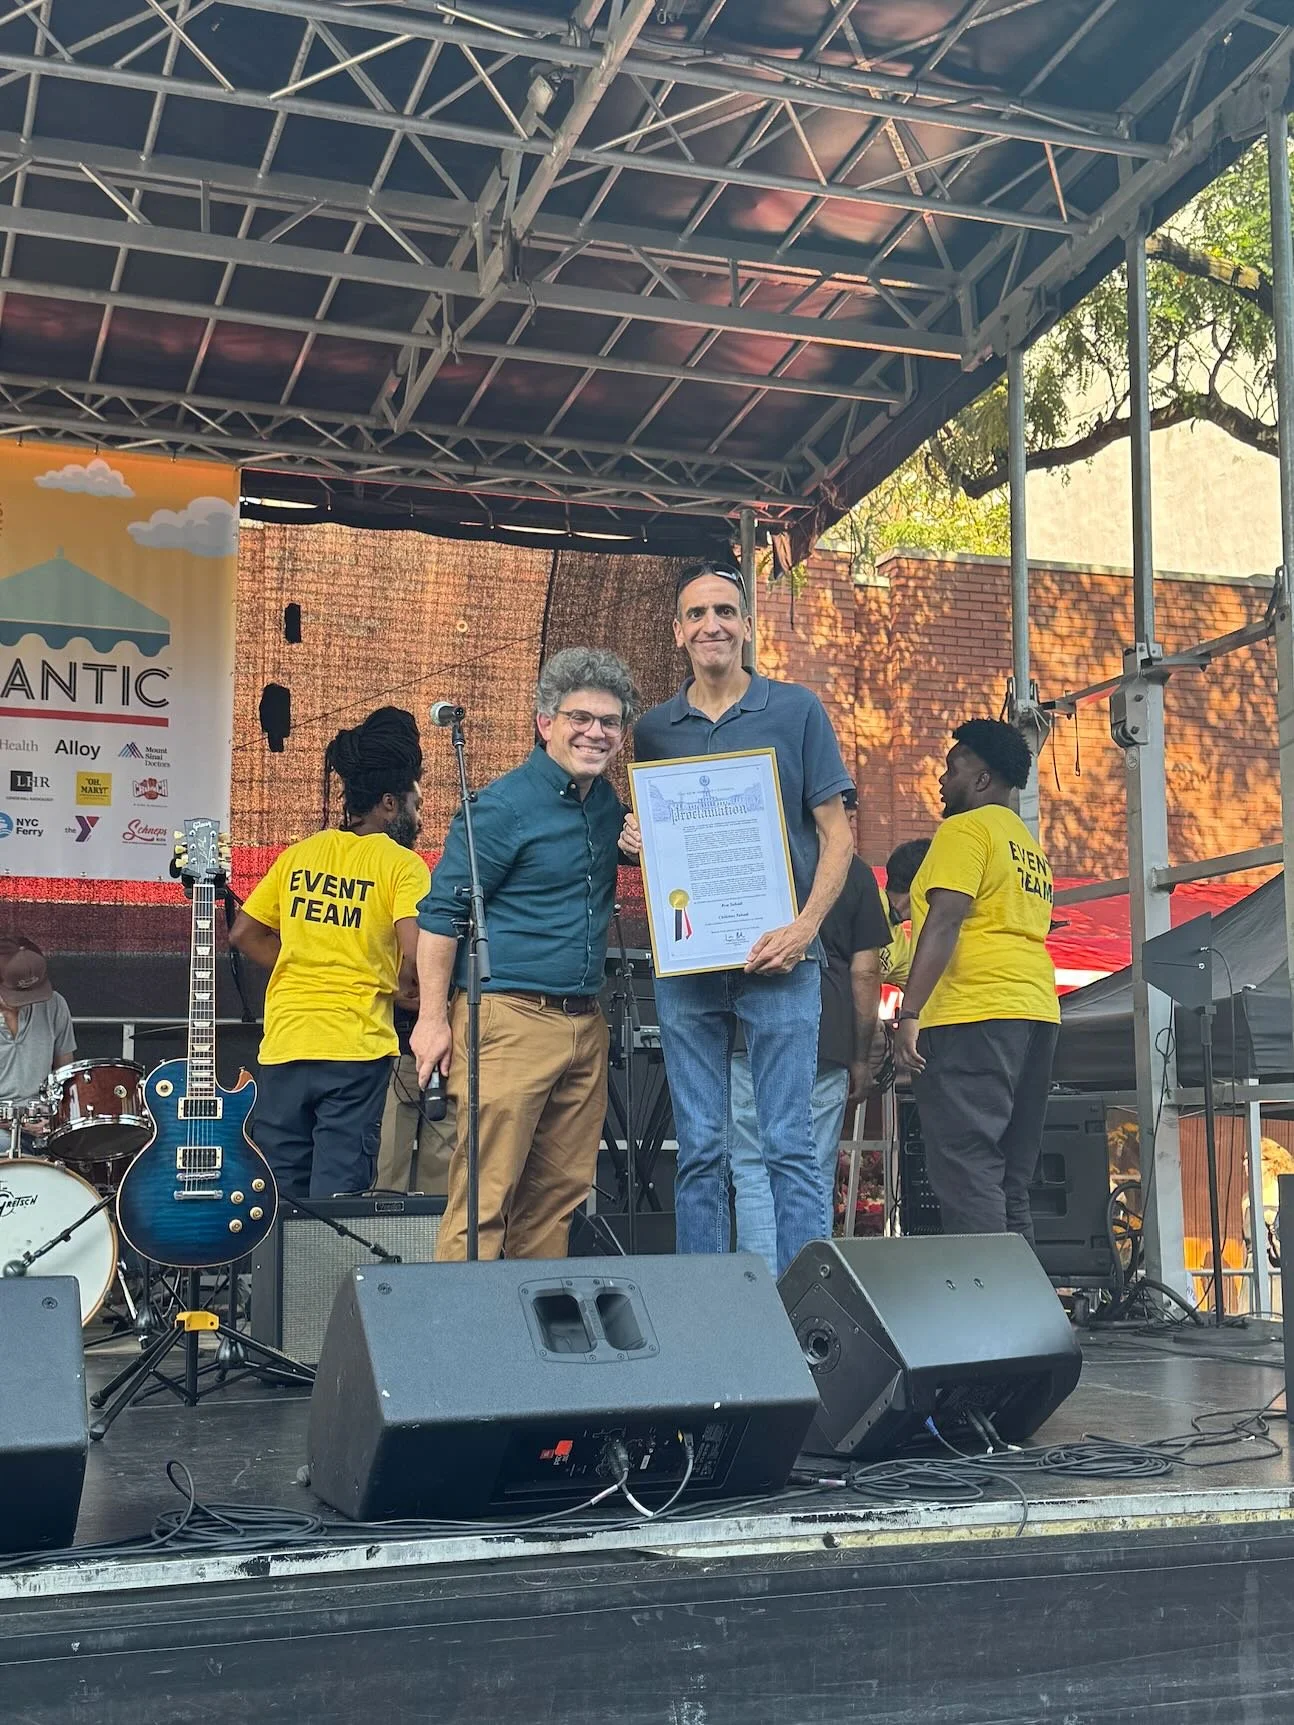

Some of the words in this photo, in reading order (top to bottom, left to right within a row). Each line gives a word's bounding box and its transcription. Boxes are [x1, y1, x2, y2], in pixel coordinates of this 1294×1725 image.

[0, 658, 169, 708] ANTIC
[0, 739, 38, 752] Health
[55, 739, 101, 760] Alloy
[145, 746, 167, 754] Mount
[145, 760, 171, 768] Doctors
[16, 775, 50, 788] LHR
[16, 818, 39, 827] NYC
[122, 819, 167, 842] Schneps
[16, 827, 44, 837] Ferry
[290, 869, 375, 902] EVENT
[1017, 867, 1053, 903] TEAM
[290, 896, 362, 929] TEAM
